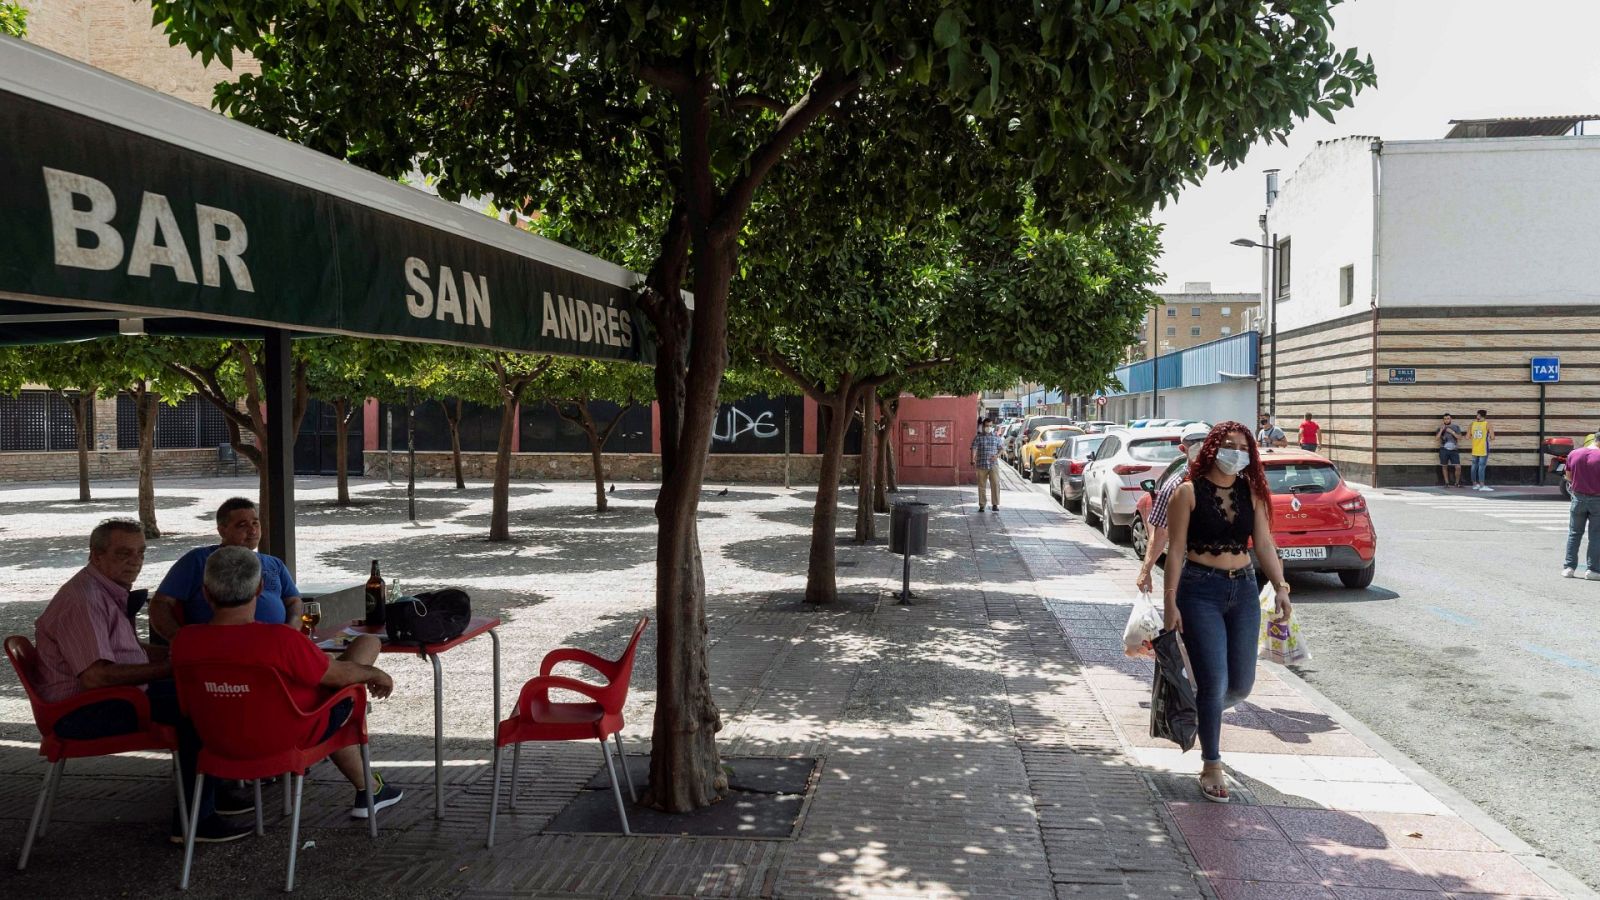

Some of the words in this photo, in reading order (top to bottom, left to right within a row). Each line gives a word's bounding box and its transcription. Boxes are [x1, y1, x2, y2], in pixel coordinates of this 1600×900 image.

[42, 166, 255, 293] BAR
[404, 256, 491, 329] SAN
[541, 291, 632, 348] ANDRÉS
[1533, 365, 1558, 374] TAXI
[1305, 547, 1323, 557] HNH
[204, 681, 250, 693] Mahou
